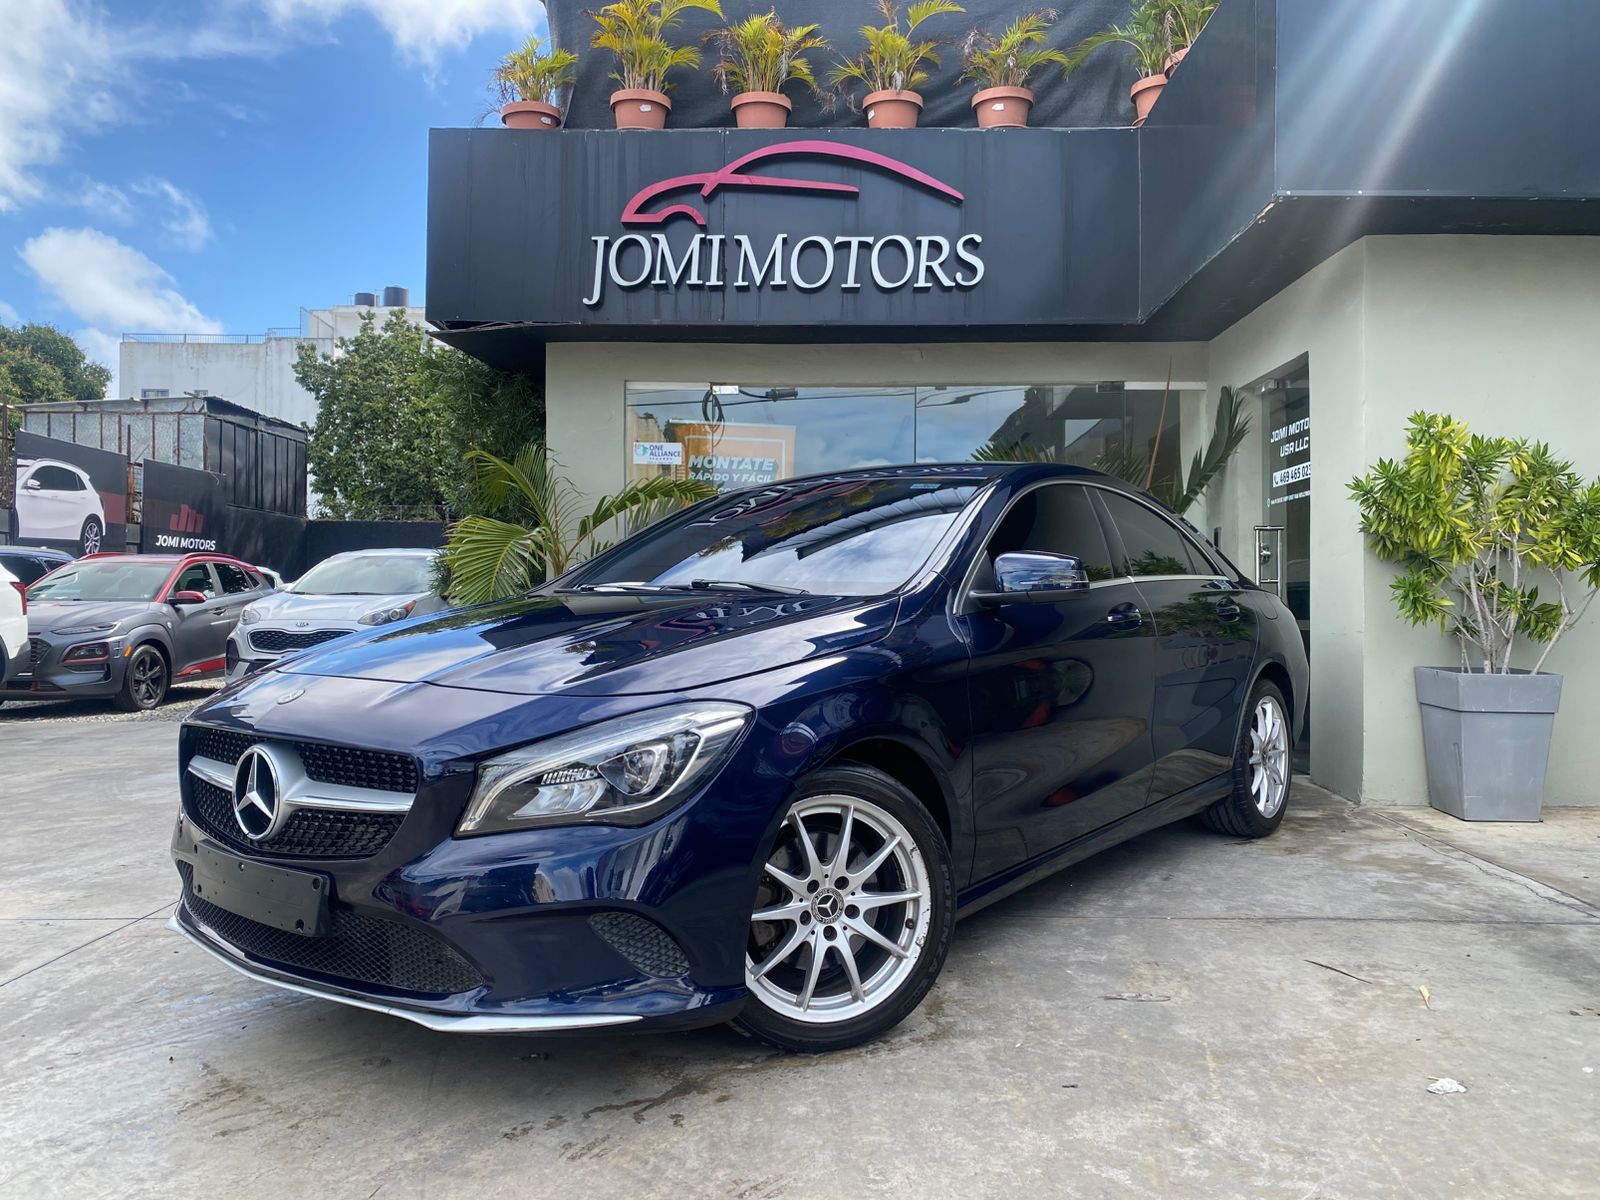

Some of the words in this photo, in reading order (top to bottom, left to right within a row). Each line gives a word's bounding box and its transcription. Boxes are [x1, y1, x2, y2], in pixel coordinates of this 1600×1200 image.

[583, 233, 725, 305] JOMI
[734, 233, 985, 289] MOTORS
[1270, 425, 1288, 443] JOMI
[649, 450, 681, 458] ALLIANCE
[1280, 442, 1294, 457] USA
[1295, 436, 1309, 452] LLC
[732, 473, 741, 482] Y
[742, 472, 772, 483] FÁCIL
[155, 534, 180, 548] JOMI
[180, 537, 216, 551] MOTORS
